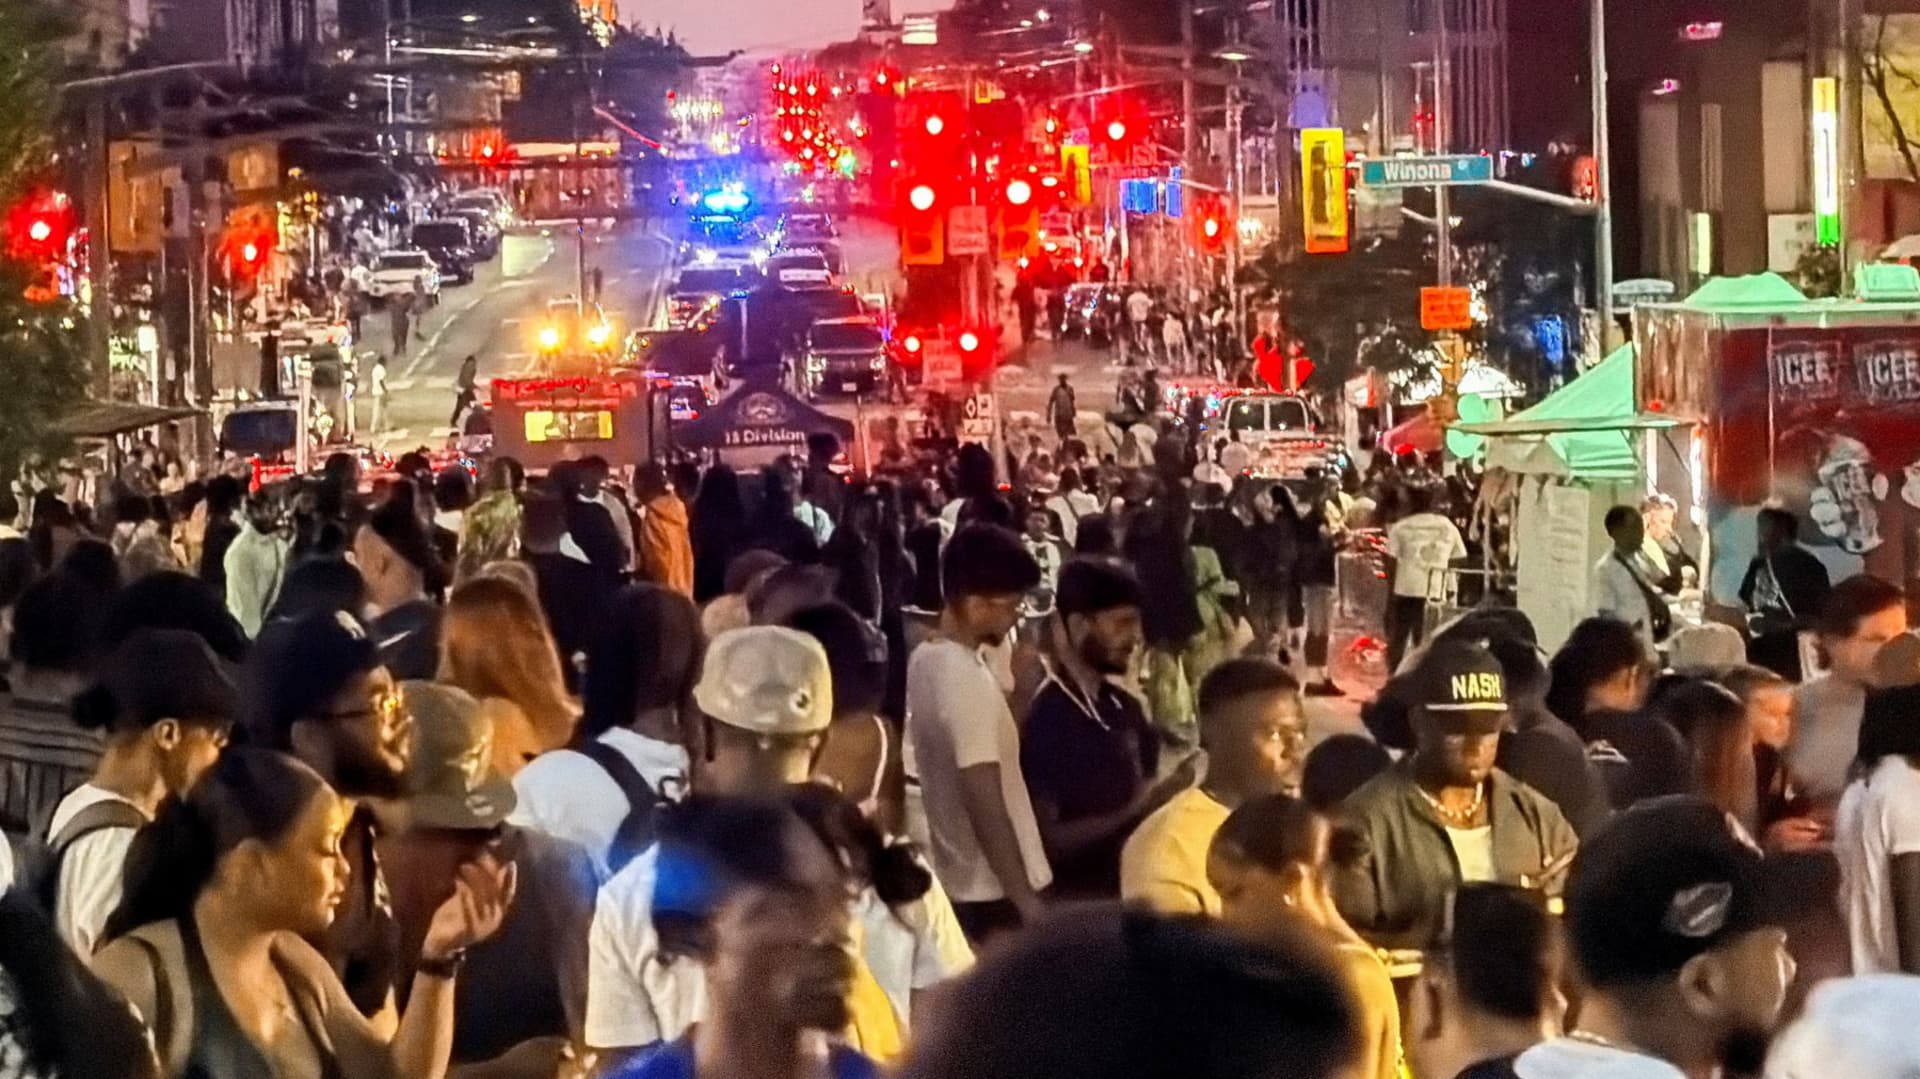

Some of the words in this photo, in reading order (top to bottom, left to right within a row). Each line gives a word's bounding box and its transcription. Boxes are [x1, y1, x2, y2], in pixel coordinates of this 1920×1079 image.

[1384, 161, 1452, 181] Winona
[1776, 351, 1832, 385] ICEE
[1866, 350, 1920, 385] ICEE
[744, 428, 805, 443] Division
[1451, 672, 1501, 699] NASH
